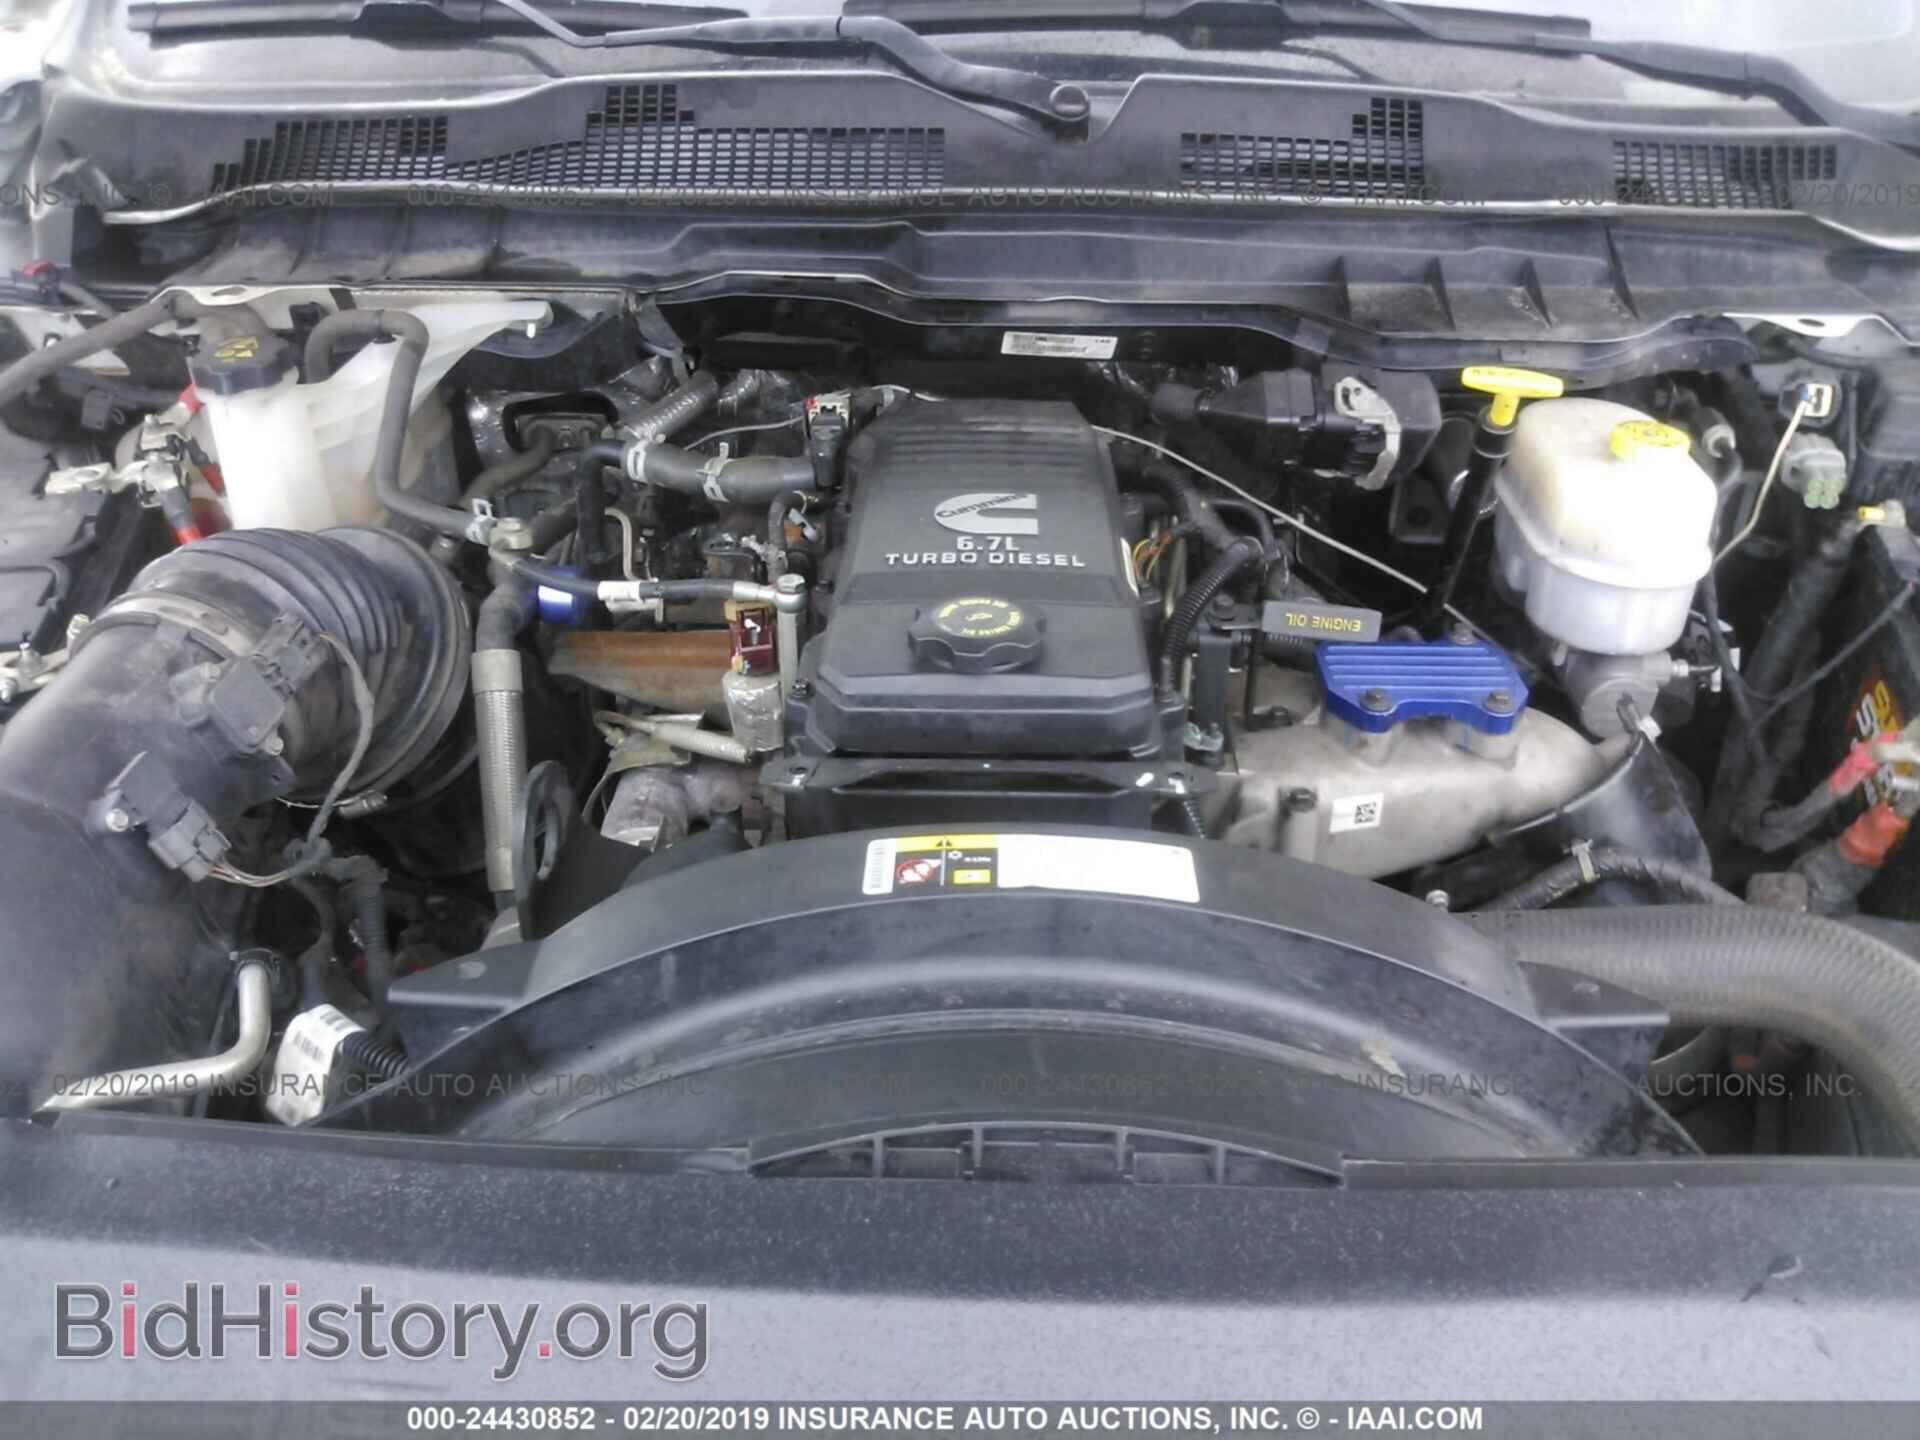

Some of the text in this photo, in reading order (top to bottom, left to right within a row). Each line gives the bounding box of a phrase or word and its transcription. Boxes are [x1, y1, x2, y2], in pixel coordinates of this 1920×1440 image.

[956, 535, 1021, 552] 6.7L
[885, 552, 1086, 568] TURBO DIESEL
[1285, 612, 1363, 633] ENGINE OIL
